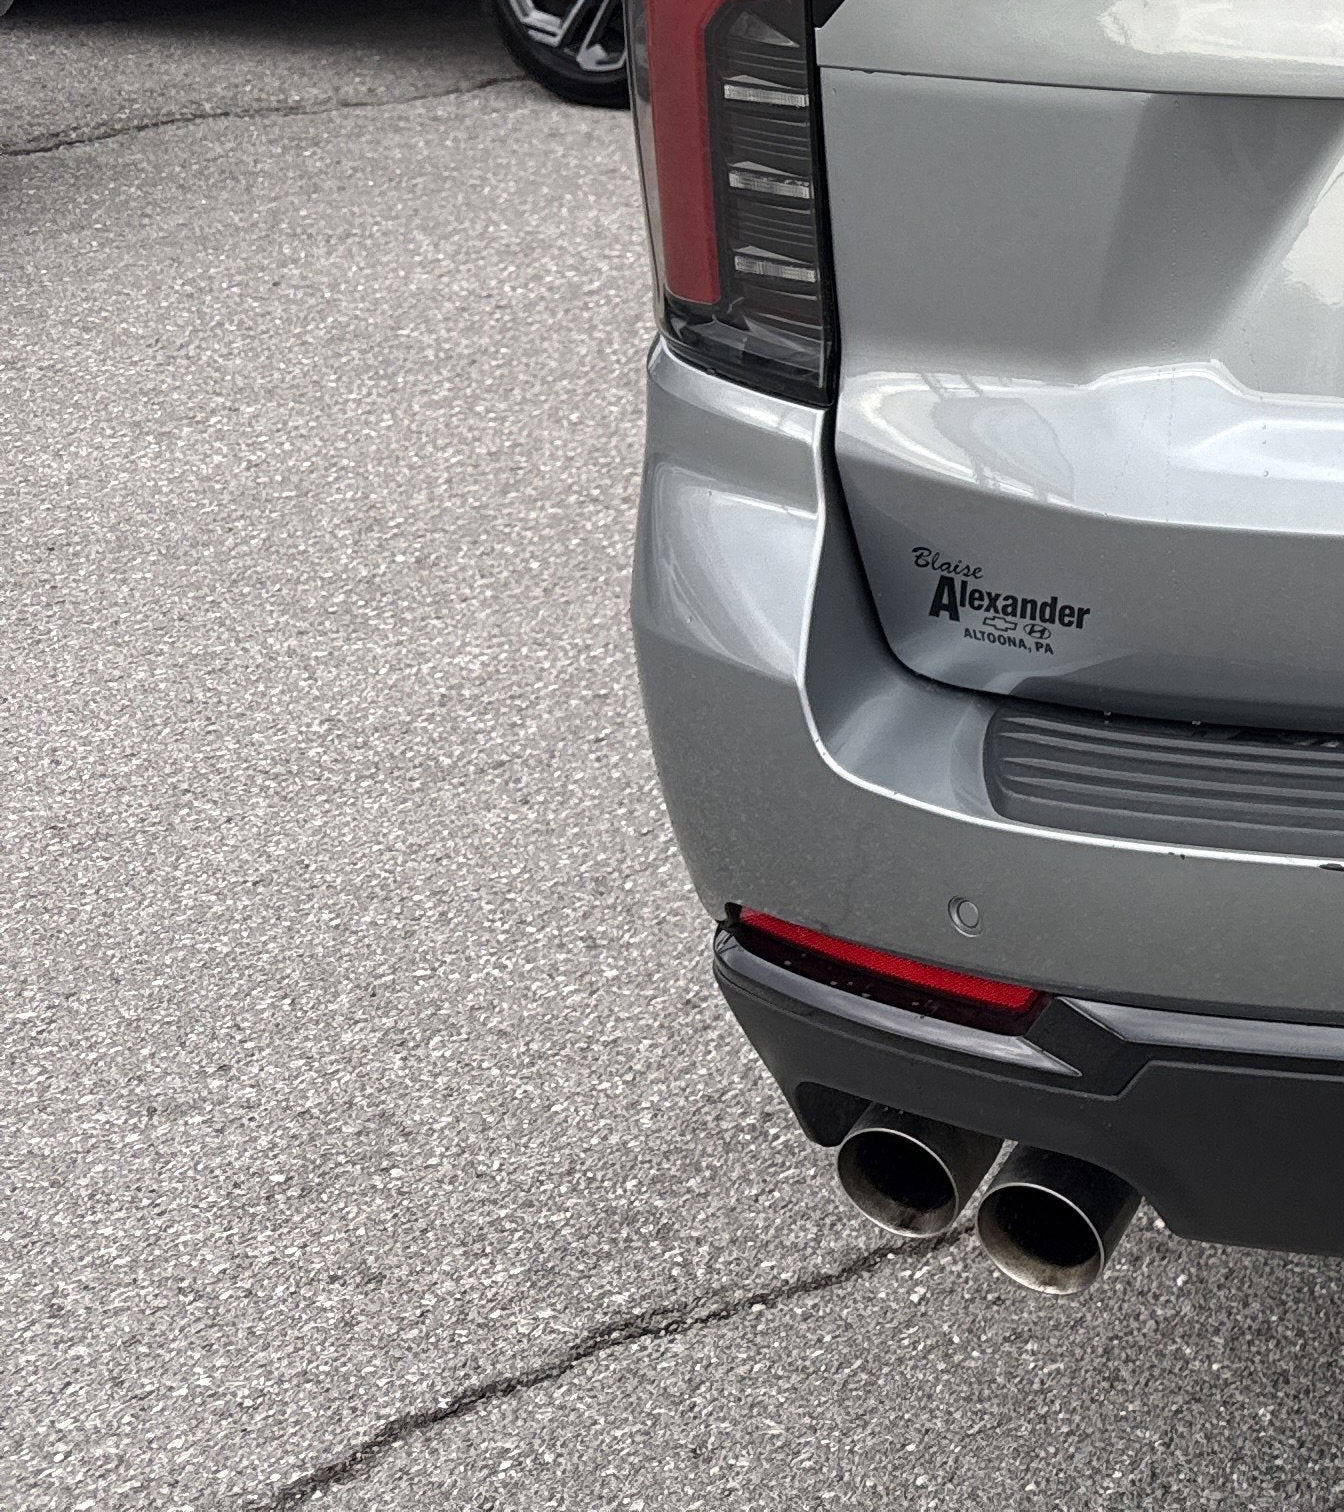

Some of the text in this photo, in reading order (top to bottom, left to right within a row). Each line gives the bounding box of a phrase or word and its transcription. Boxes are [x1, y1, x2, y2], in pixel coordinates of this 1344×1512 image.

[911, 546, 984, 580] Blaise
[928, 574, 1091, 630] Alexander
[963, 627, 1055, 656] ALTOONA, PA
